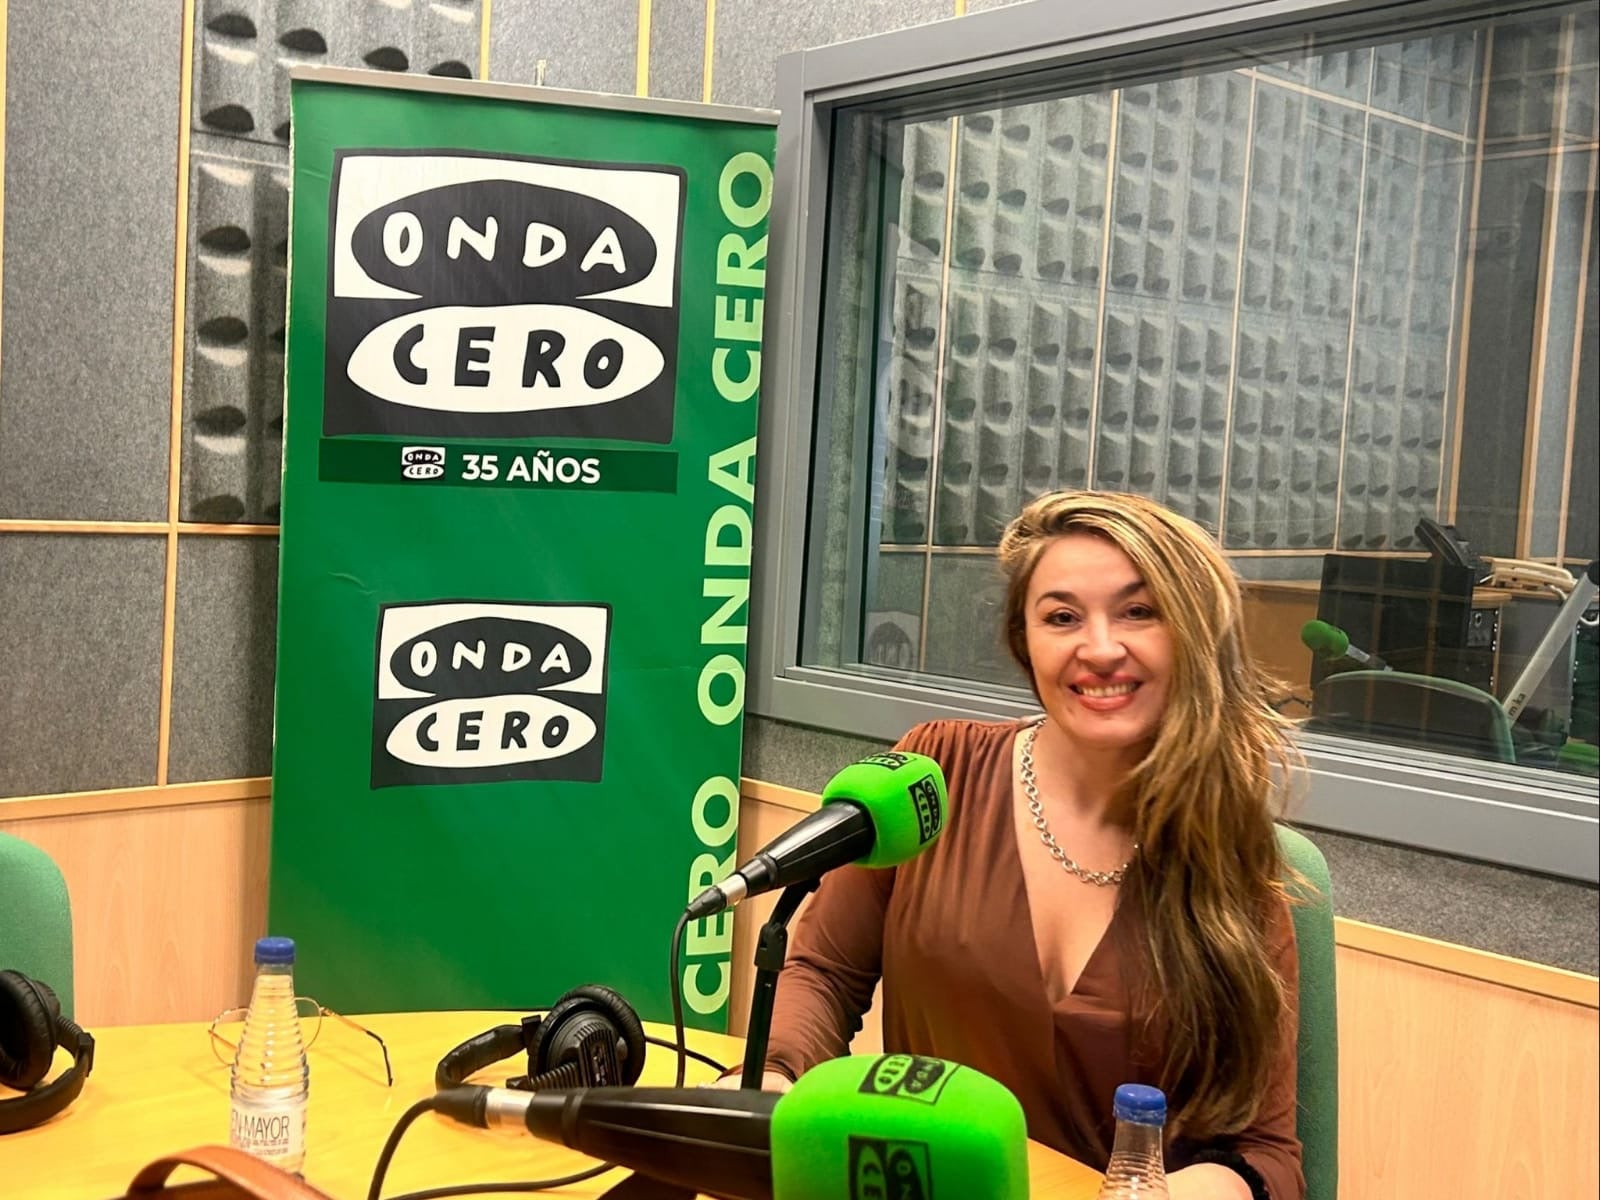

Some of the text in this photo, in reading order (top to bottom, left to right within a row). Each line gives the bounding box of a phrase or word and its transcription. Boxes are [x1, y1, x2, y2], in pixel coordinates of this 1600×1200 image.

[382, 211, 627, 274] ONDA
[392, 323, 625, 390] CERO
[407, 453, 439, 461] ONDA
[409, 467, 439, 475] CERO
[461, 450, 600, 484] 35 AÑOS
[683, 151, 774, 1015] CERO ONDA CERO
[410, 640, 572, 677] ONDA
[415, 710, 570, 752] CERO
